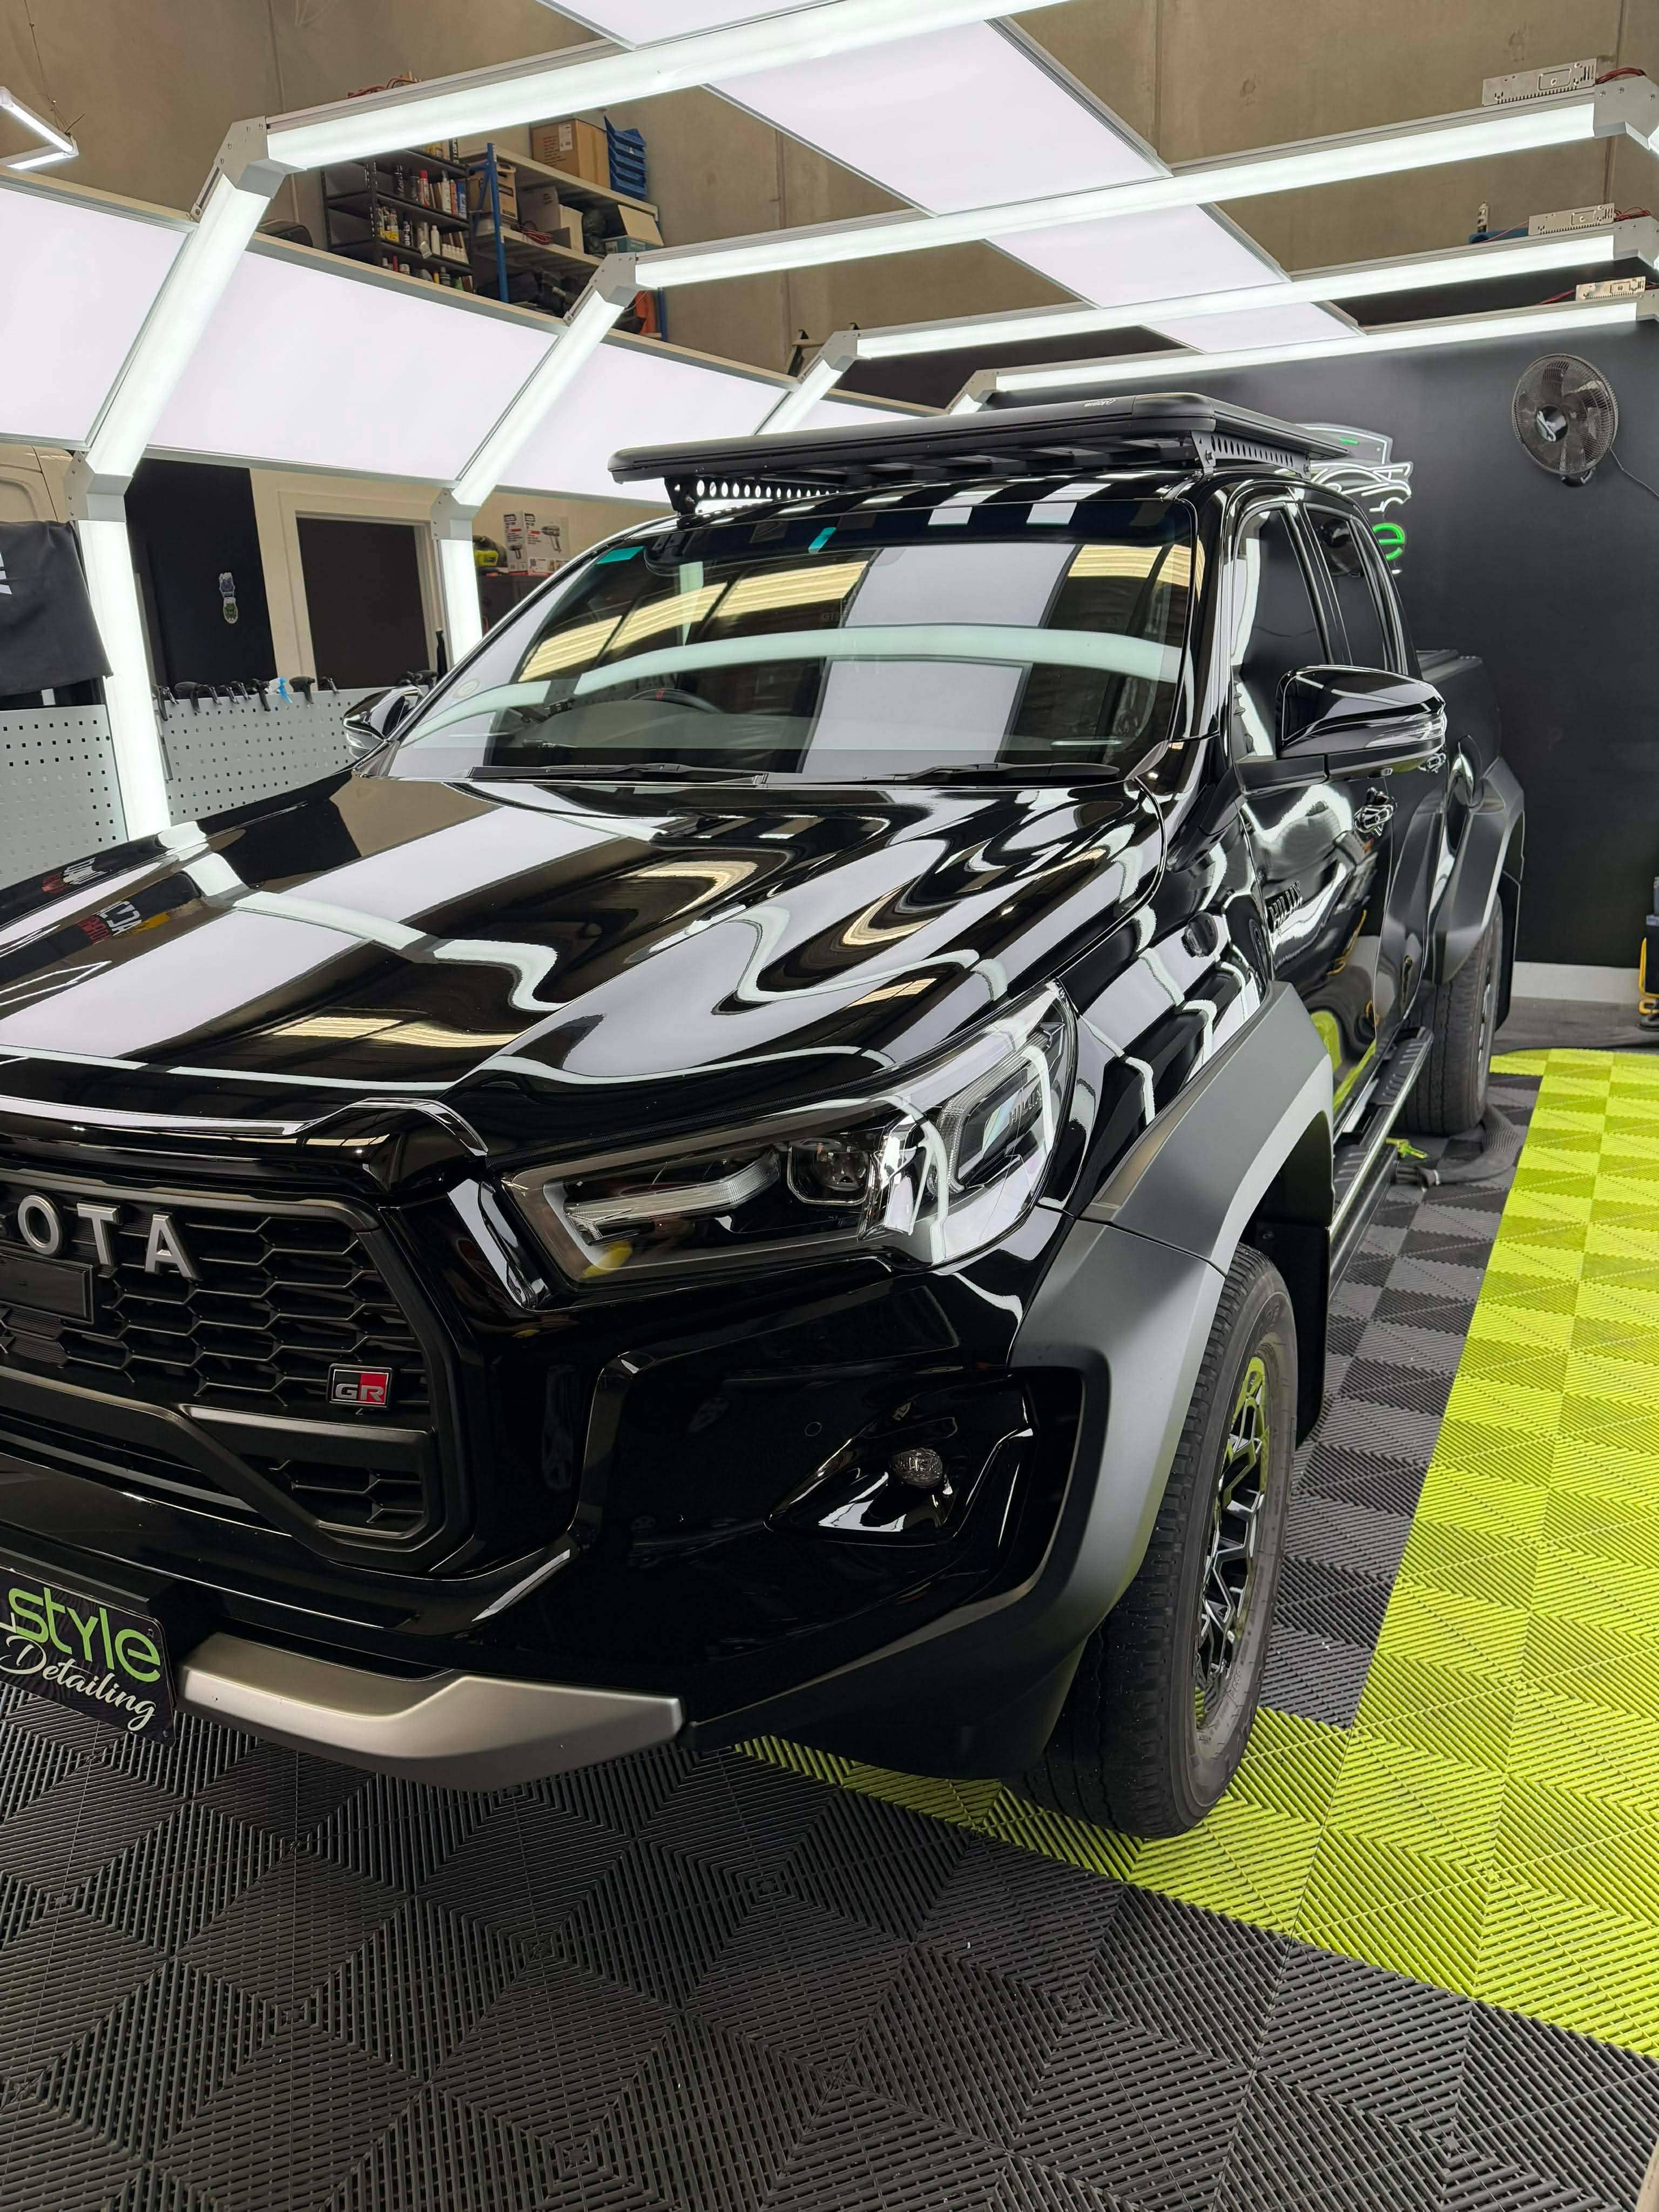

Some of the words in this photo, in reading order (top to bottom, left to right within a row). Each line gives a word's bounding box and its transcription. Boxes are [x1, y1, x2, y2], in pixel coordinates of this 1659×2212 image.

[1268, 881, 1303, 932] HILUX
[335, 1383, 384, 1401] GR
[9, 1587, 160, 1682] style
[0, 1635, 156, 1731] Detailing
